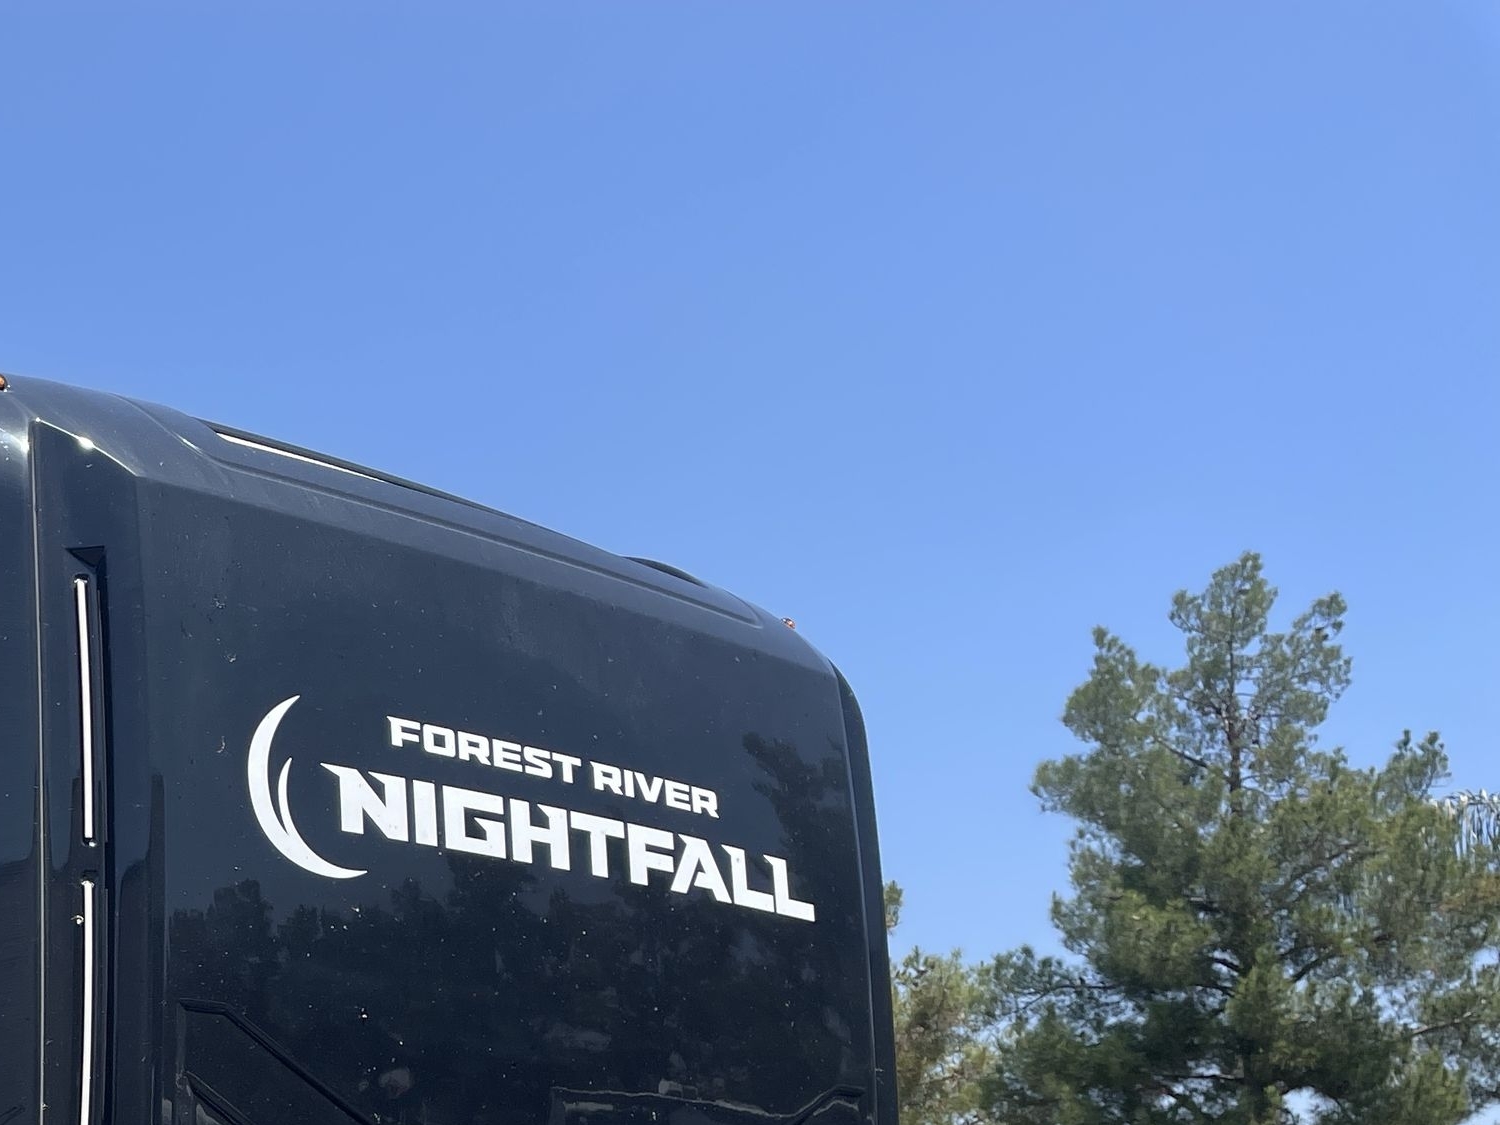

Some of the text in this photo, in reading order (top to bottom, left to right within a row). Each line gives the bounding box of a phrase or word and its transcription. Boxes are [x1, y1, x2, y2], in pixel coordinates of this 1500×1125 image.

[386, 715, 720, 819] FOREST RIVER
[320, 762, 816, 923] NIGHTFALL
